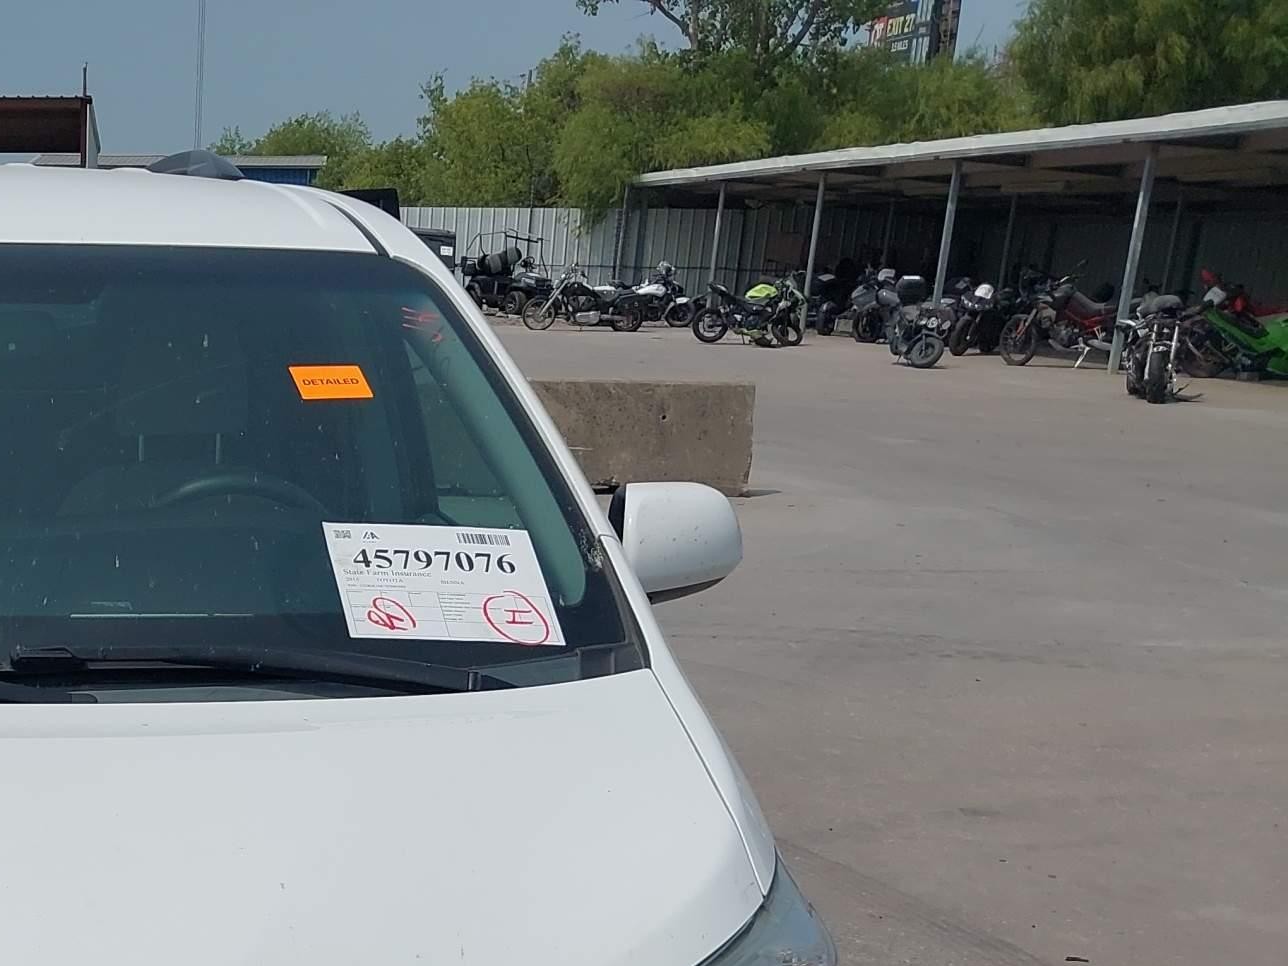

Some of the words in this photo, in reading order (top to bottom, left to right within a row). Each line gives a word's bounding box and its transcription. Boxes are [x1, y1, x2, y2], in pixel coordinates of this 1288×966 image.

[302, 377, 360, 386] DETAILED
[353, 548, 516, 575] 45797076
[343, 568, 364, 576] State
[366, 569, 389, 577] Farm
[392, 569, 433, 578] Insurance
